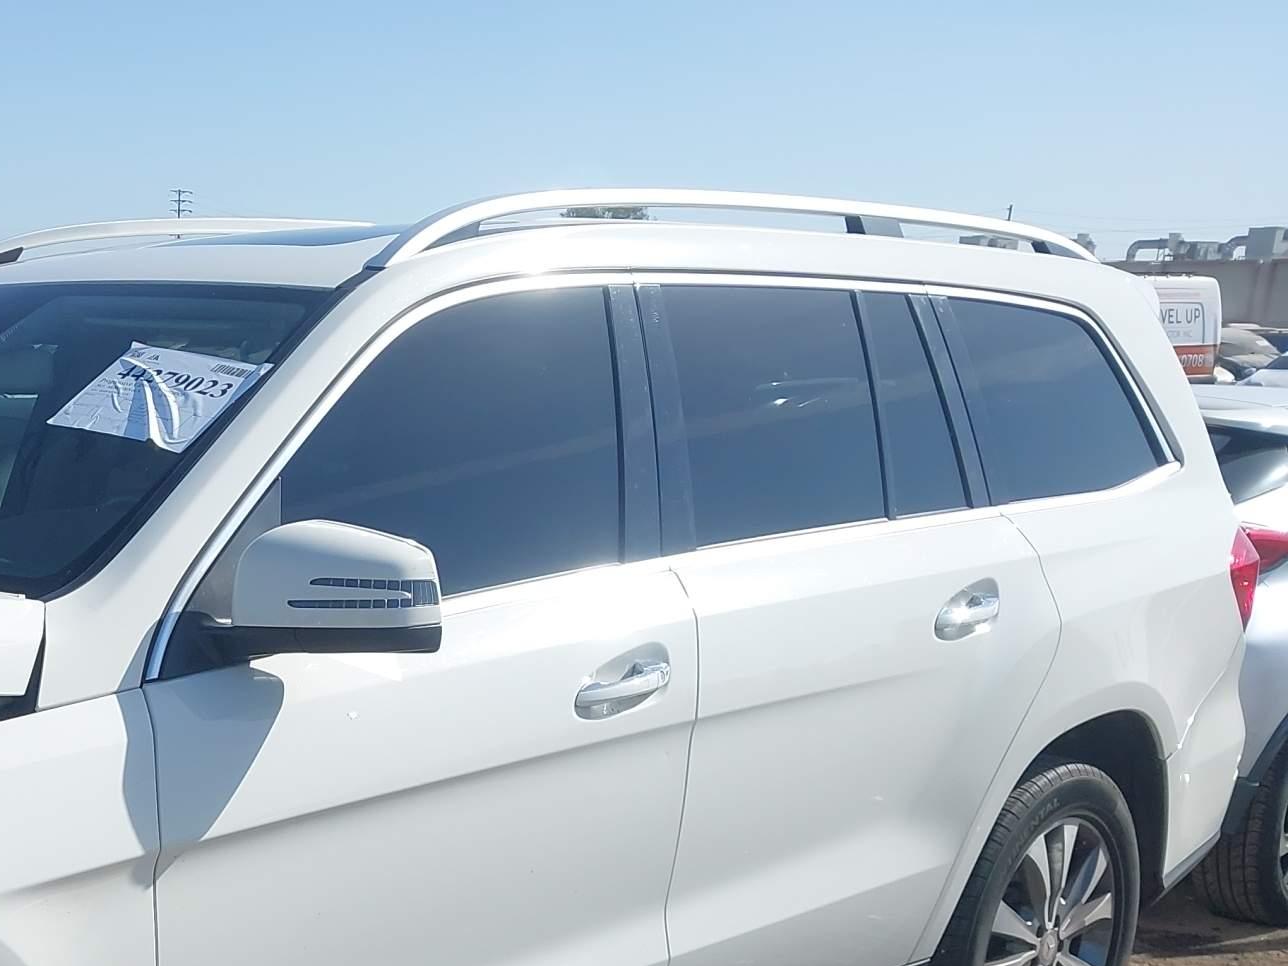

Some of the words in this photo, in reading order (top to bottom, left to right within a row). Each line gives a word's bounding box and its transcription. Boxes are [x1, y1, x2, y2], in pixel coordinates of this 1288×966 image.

[1160, 308, 1182, 324] VEL
[1185, 308, 1201, 324] UP
[1181, 354, 1203, 367] 0708
